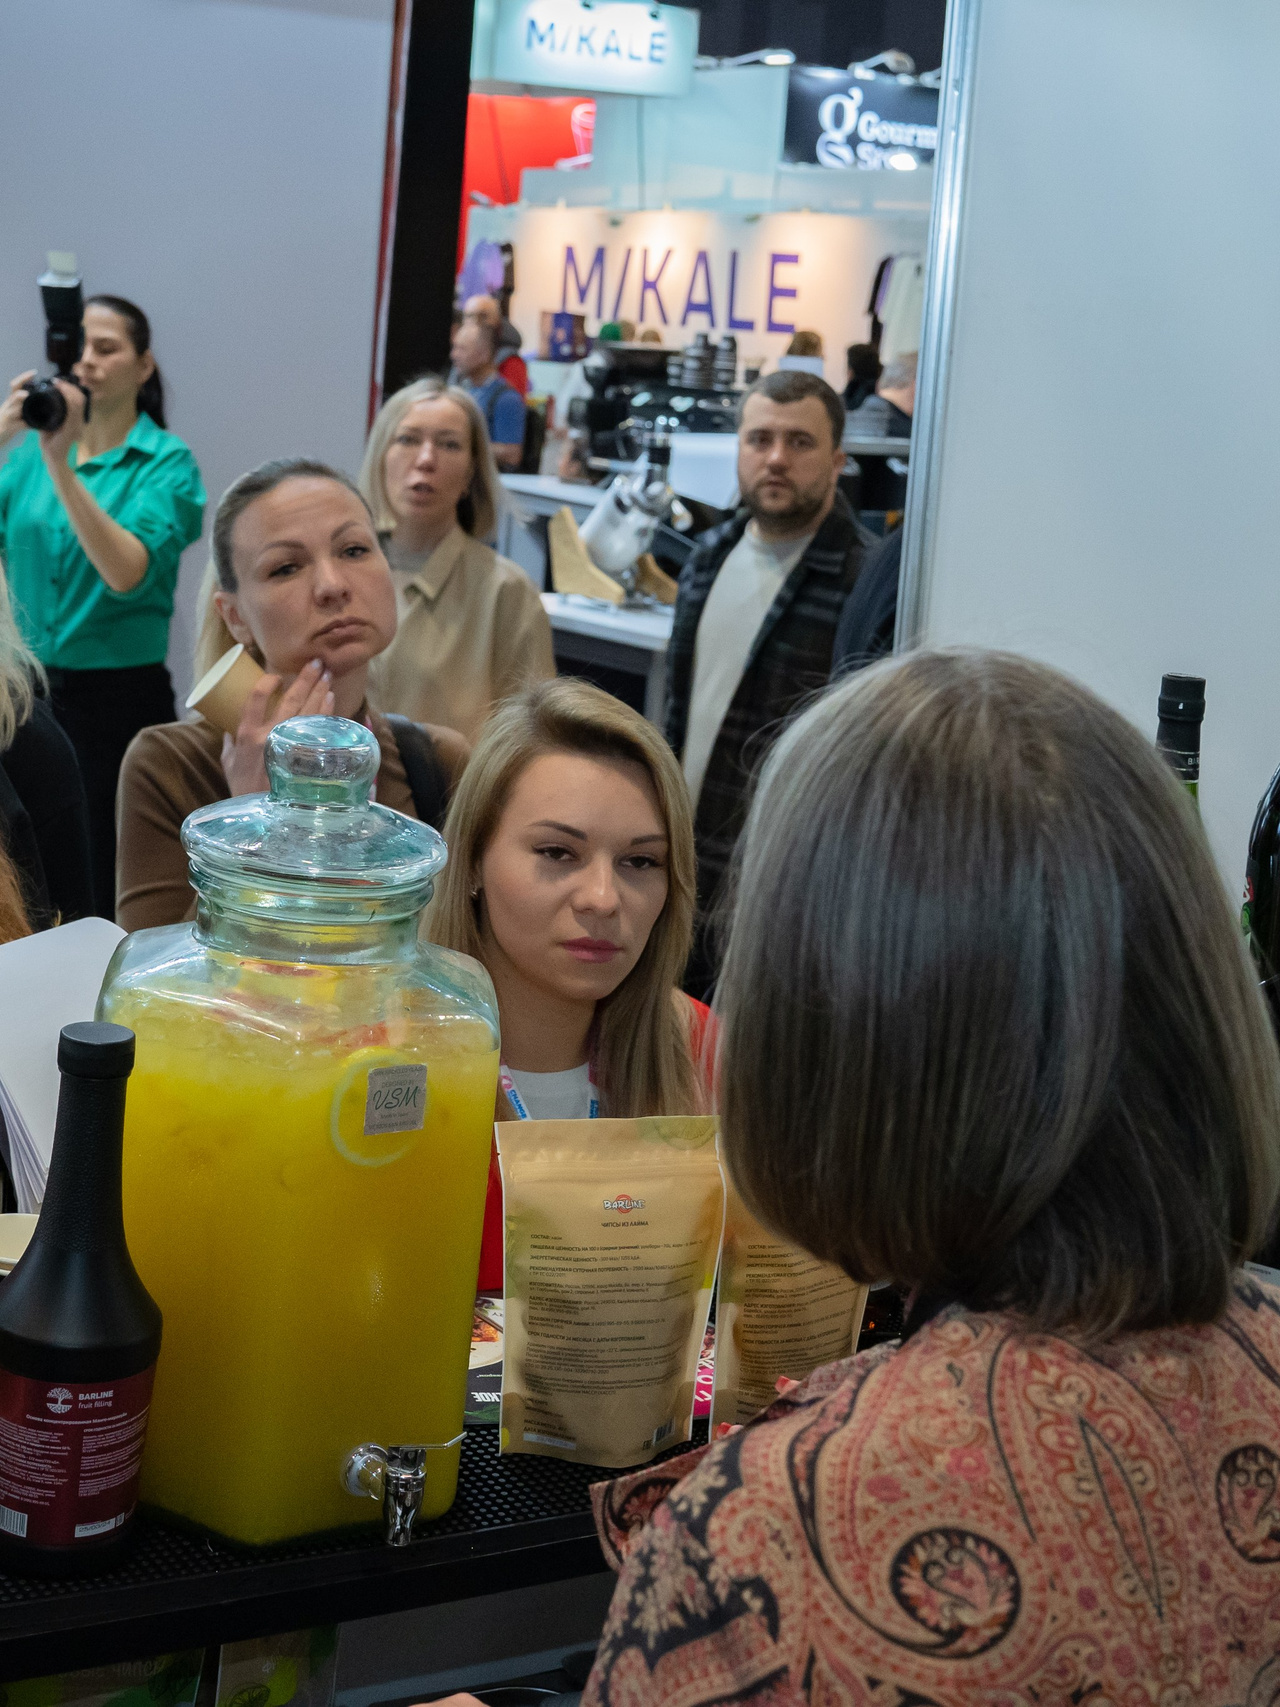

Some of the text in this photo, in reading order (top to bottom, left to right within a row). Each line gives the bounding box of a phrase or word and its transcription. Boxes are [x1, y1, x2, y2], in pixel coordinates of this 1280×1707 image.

[561, 246, 799, 334] M/KALE
[373, 1086, 419, 1110] VSM
[509, 1089, 528, 1119] CHANGE
[603, 1199, 646, 1210] BARLINE
[630, 1219, 649, 1227] ЛАЙМА
[78, 1390, 114, 1401] BARLINE
[78, 1400, 113, 1409] fruit filling
